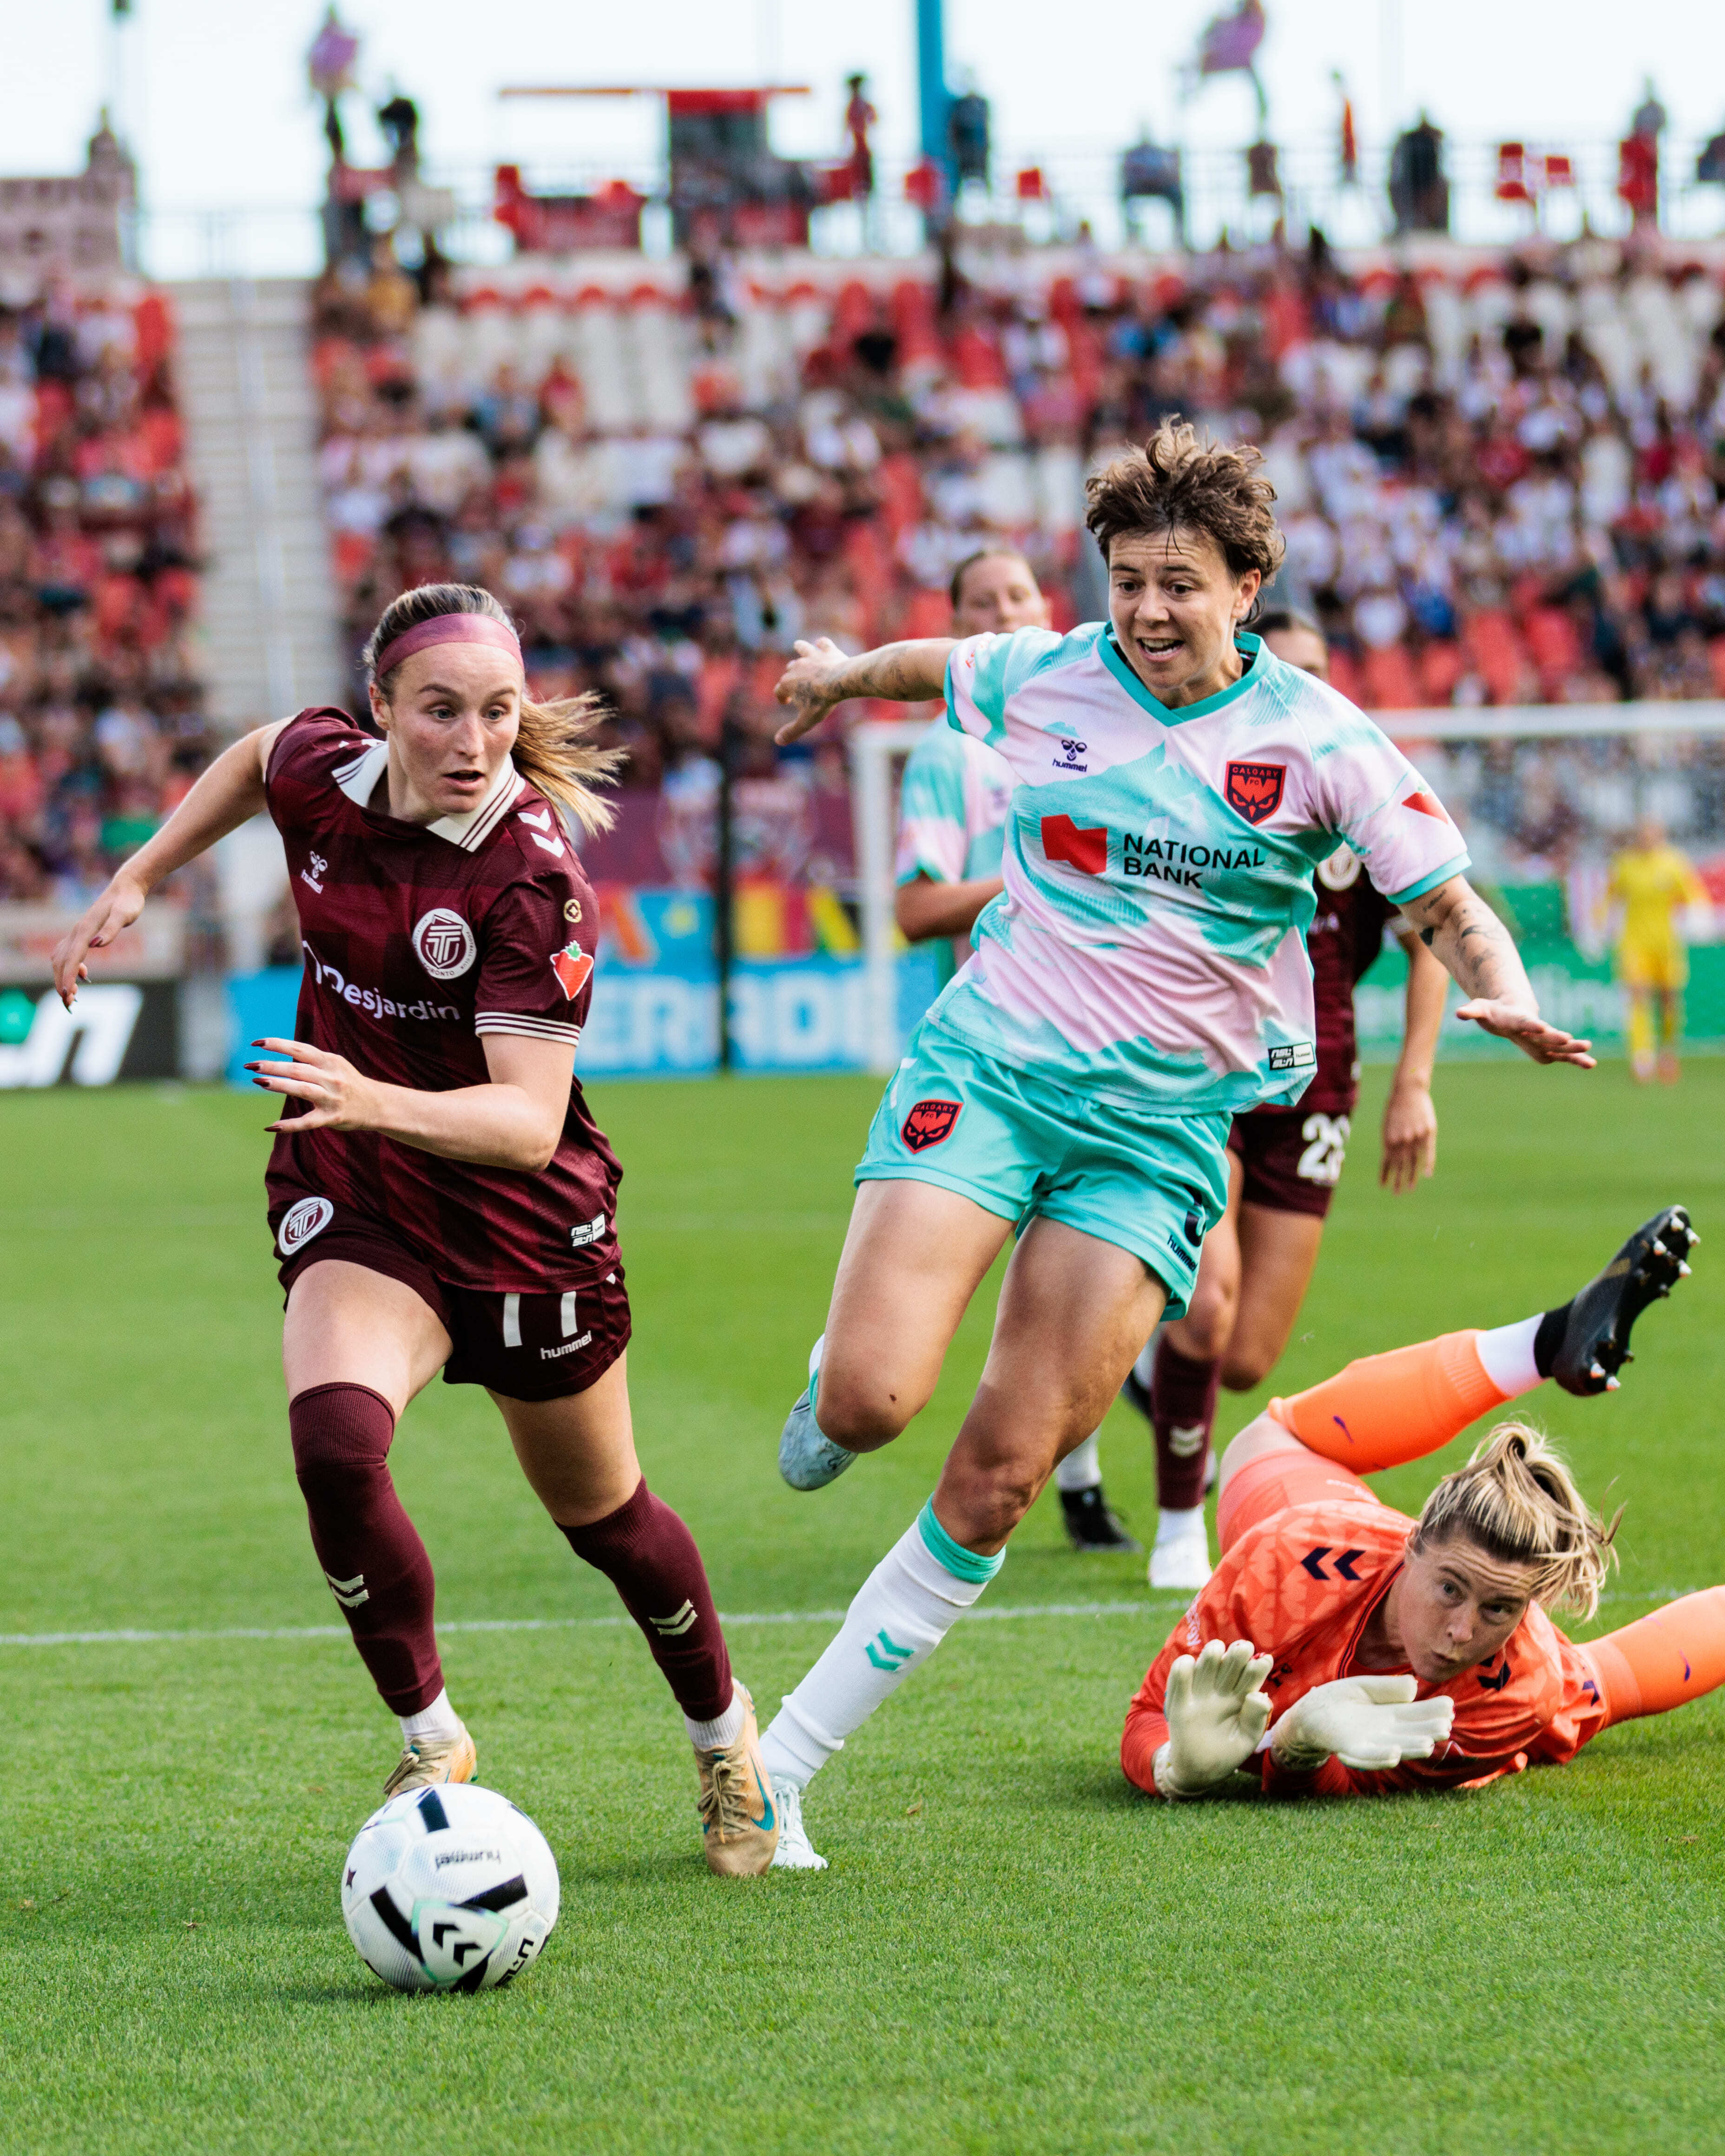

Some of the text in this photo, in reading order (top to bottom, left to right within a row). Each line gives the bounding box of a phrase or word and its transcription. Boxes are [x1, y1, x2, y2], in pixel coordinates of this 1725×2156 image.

[1053, 758, 1087, 772] hummel
[1232, 767, 1278, 777] CALGARY
[1124, 833, 1265, 869] NATIONAL
[1124, 856, 1203, 889] BANK
[323, 965, 461, 1019] Desjardin
[540, 1330, 592, 1360] hummel
